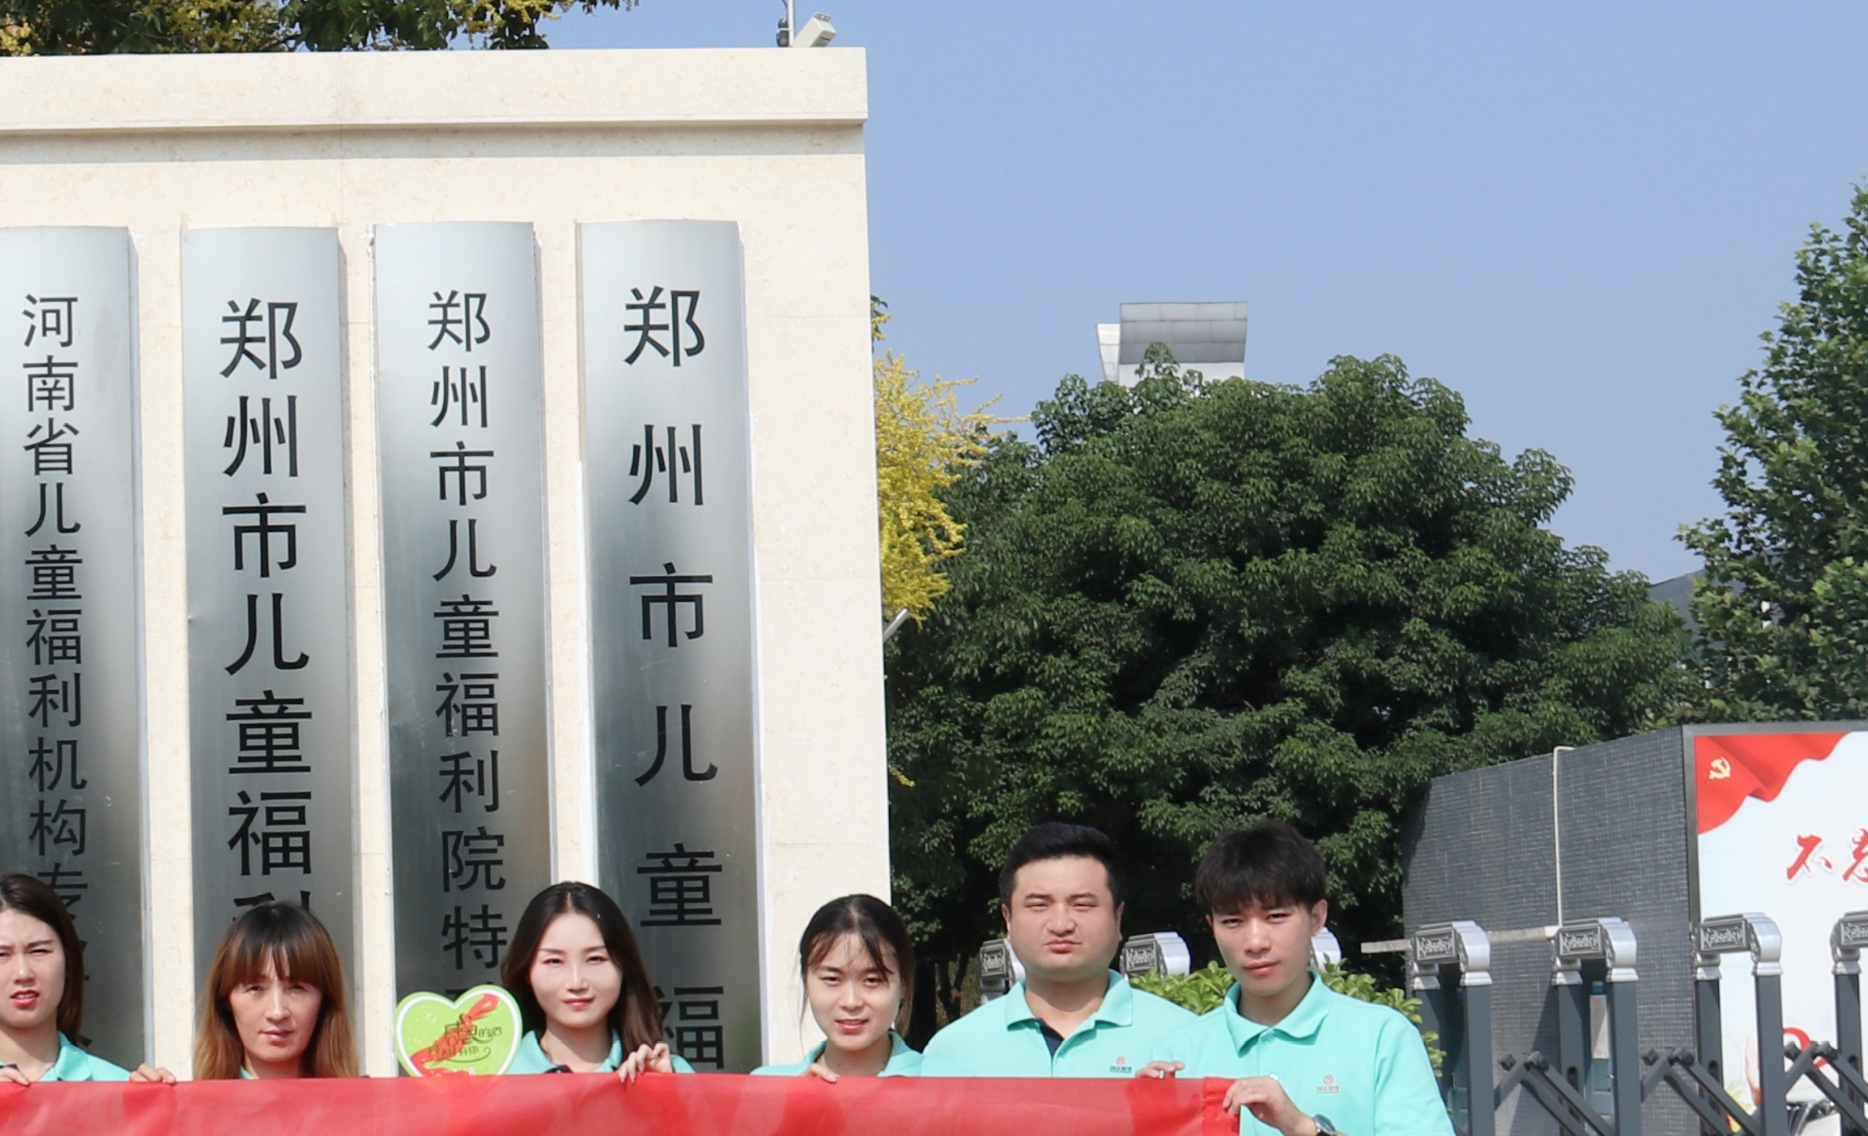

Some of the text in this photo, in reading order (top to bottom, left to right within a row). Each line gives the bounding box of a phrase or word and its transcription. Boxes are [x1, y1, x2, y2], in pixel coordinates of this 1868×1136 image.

[219, 298, 313, 918] 郑州市儿童福
[427, 290, 509, 999] 郑州市儿童福利院特
